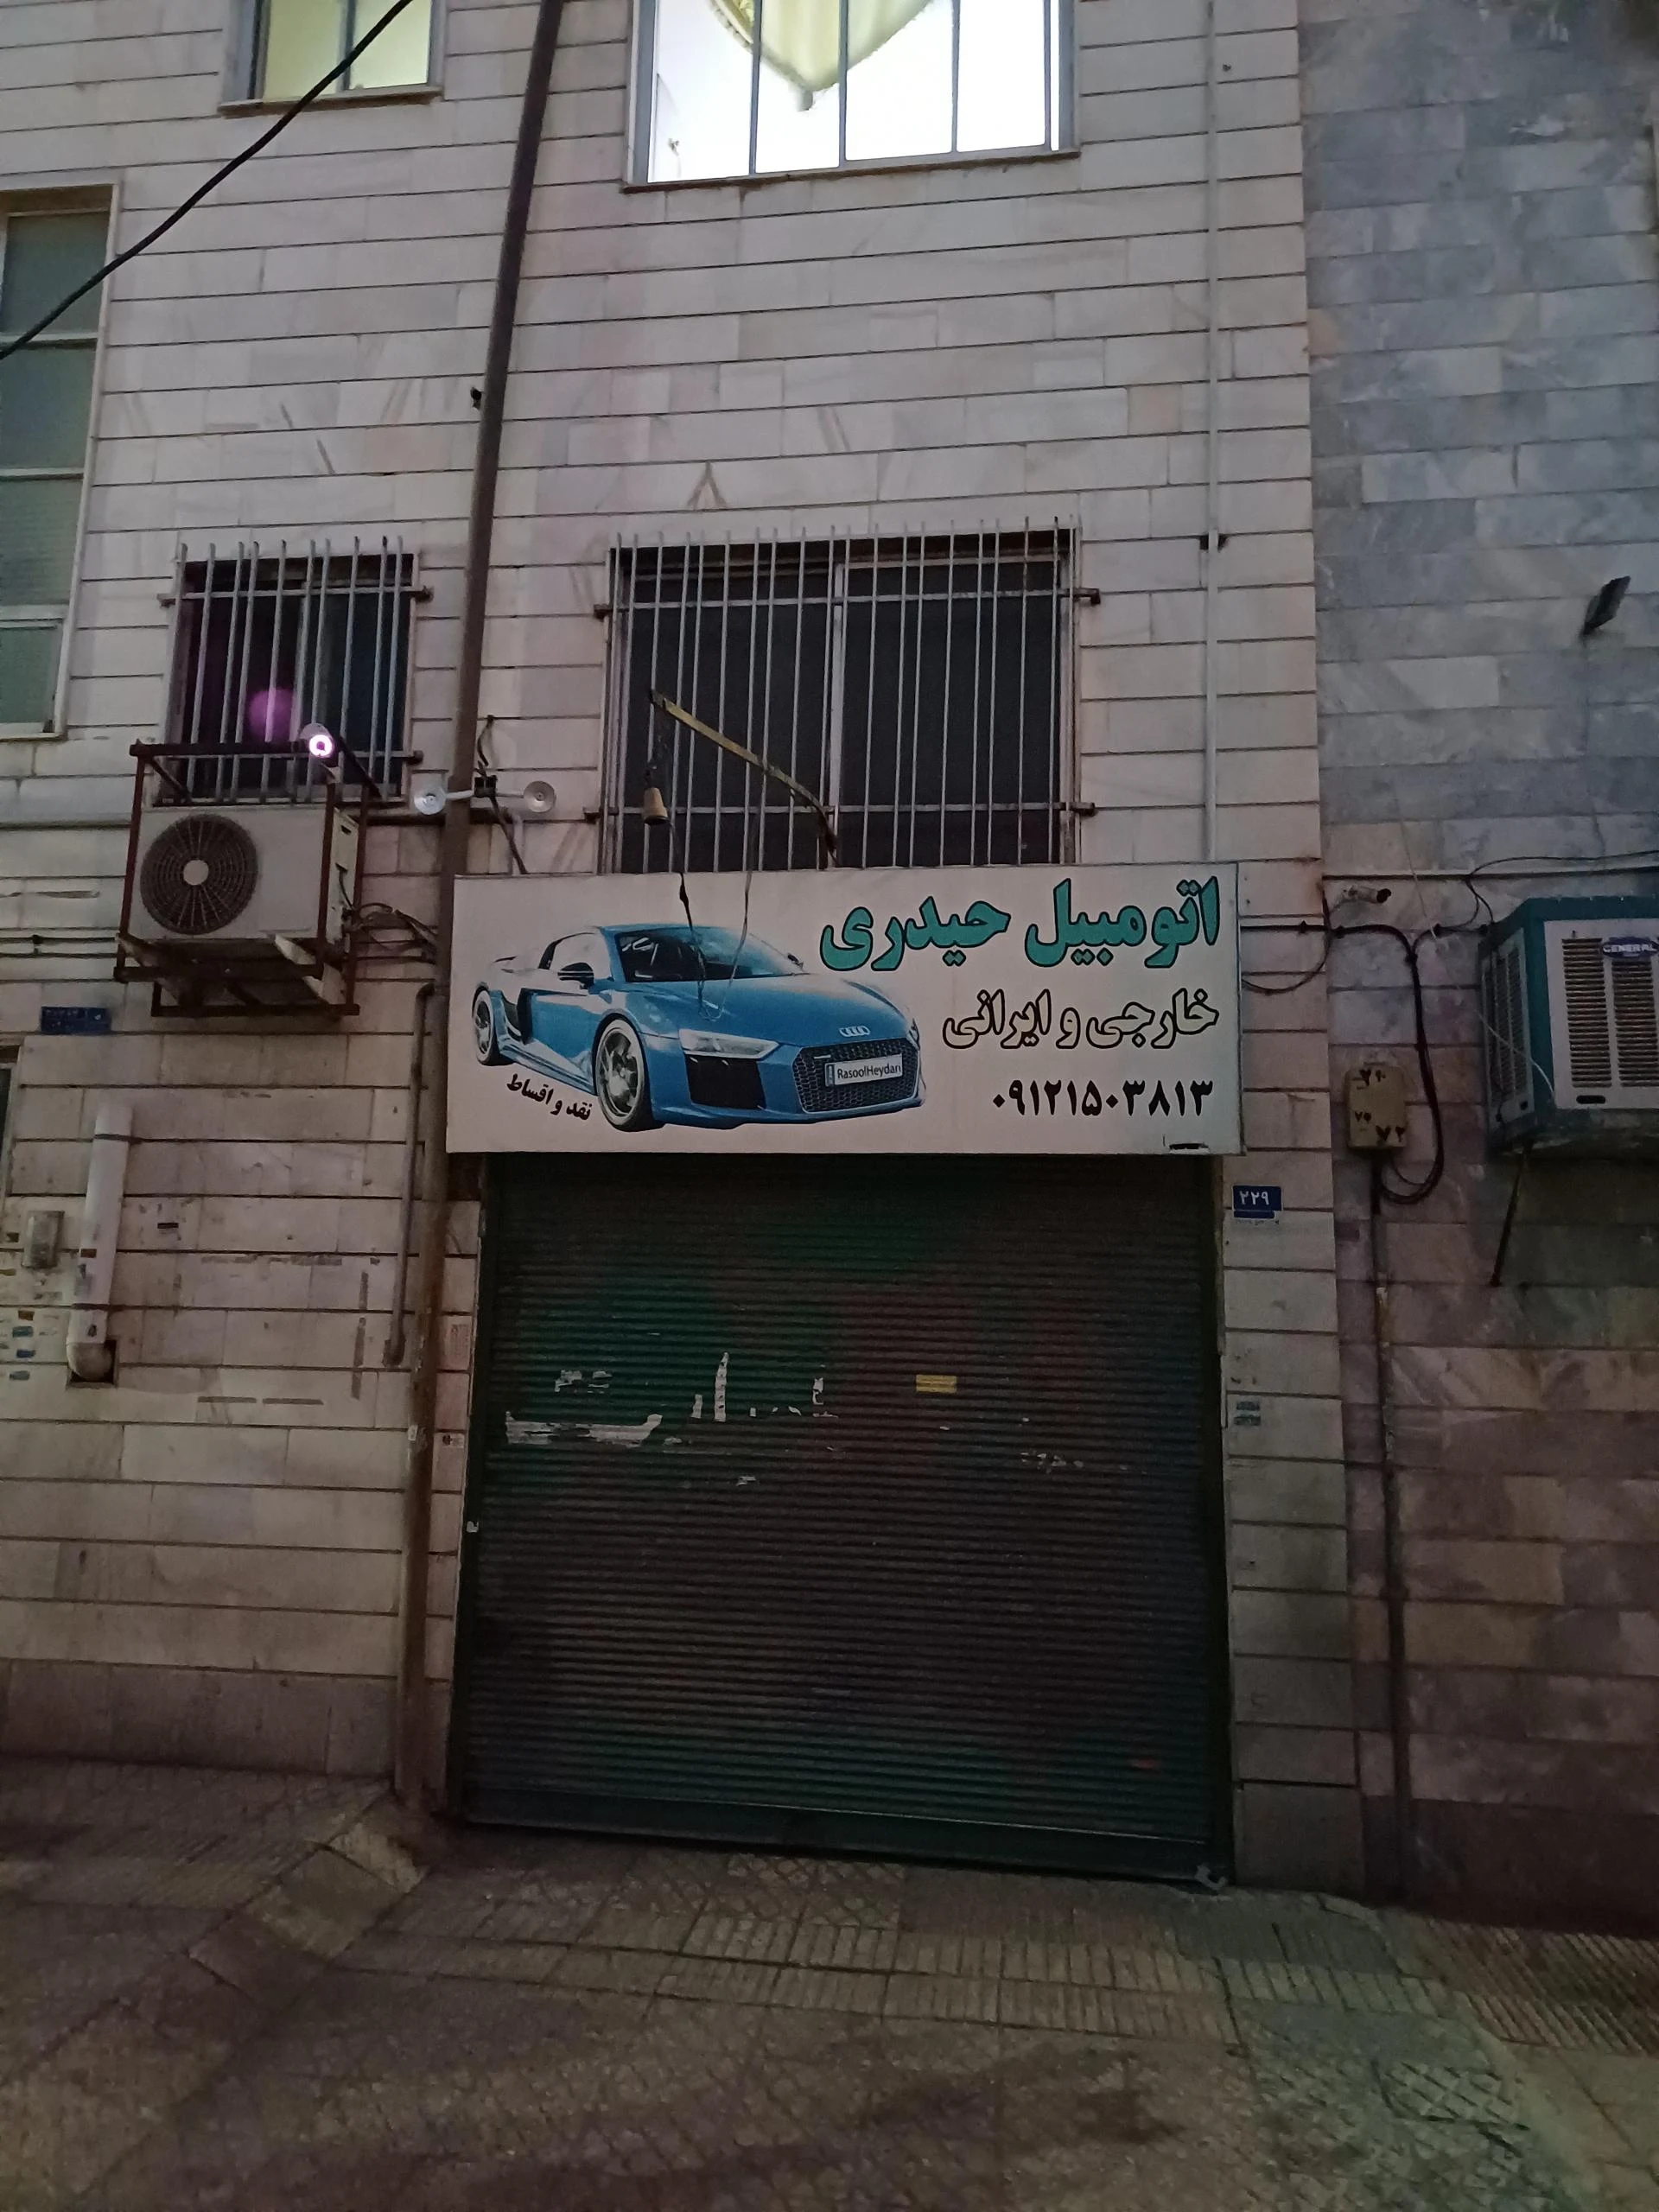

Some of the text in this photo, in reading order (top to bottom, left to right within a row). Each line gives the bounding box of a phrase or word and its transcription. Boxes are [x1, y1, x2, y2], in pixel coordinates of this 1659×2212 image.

[820, 876, 1220, 971] اتومبیل حیدری
[943, 988, 1220, 1049] خارجی و ایرانی
[506, 1073, 593, 1121] نقد و اقساط
[993, 1079, 1213, 1116] ۰۹۱۲۱۵۰۳۸۱۳
[1240, 1191, 1269, 1205] ۲۲۹
